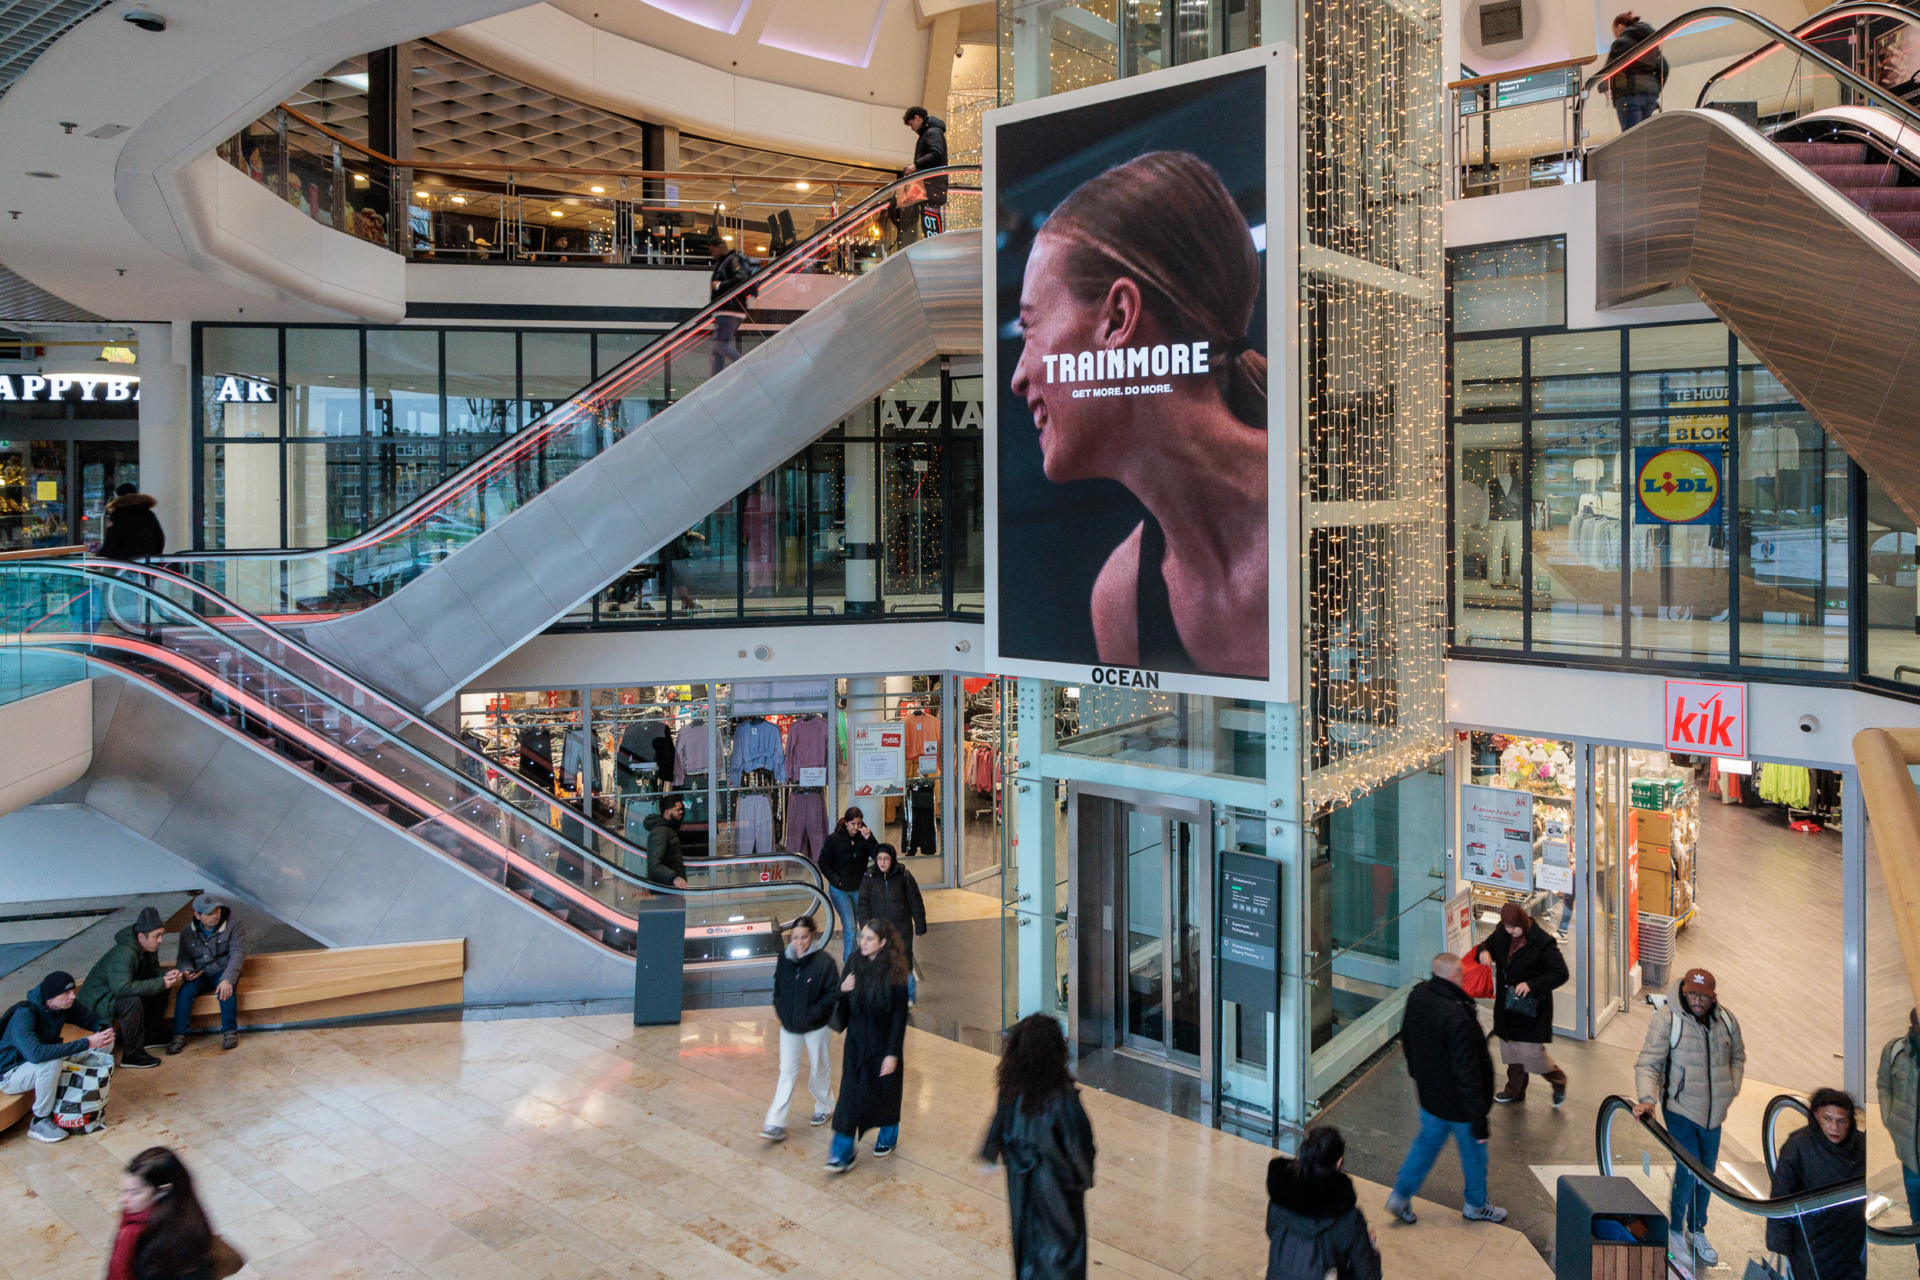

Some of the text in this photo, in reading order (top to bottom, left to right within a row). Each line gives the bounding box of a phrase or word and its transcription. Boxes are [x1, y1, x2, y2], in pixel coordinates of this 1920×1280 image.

[1043, 341, 1209, 384] TRAINMORE
[1072, 384, 1174, 398] GET MORE. DO MORE.
[1675, 391, 1691, 400] TE
[1092, 667, 1159, 689] OCEAN
